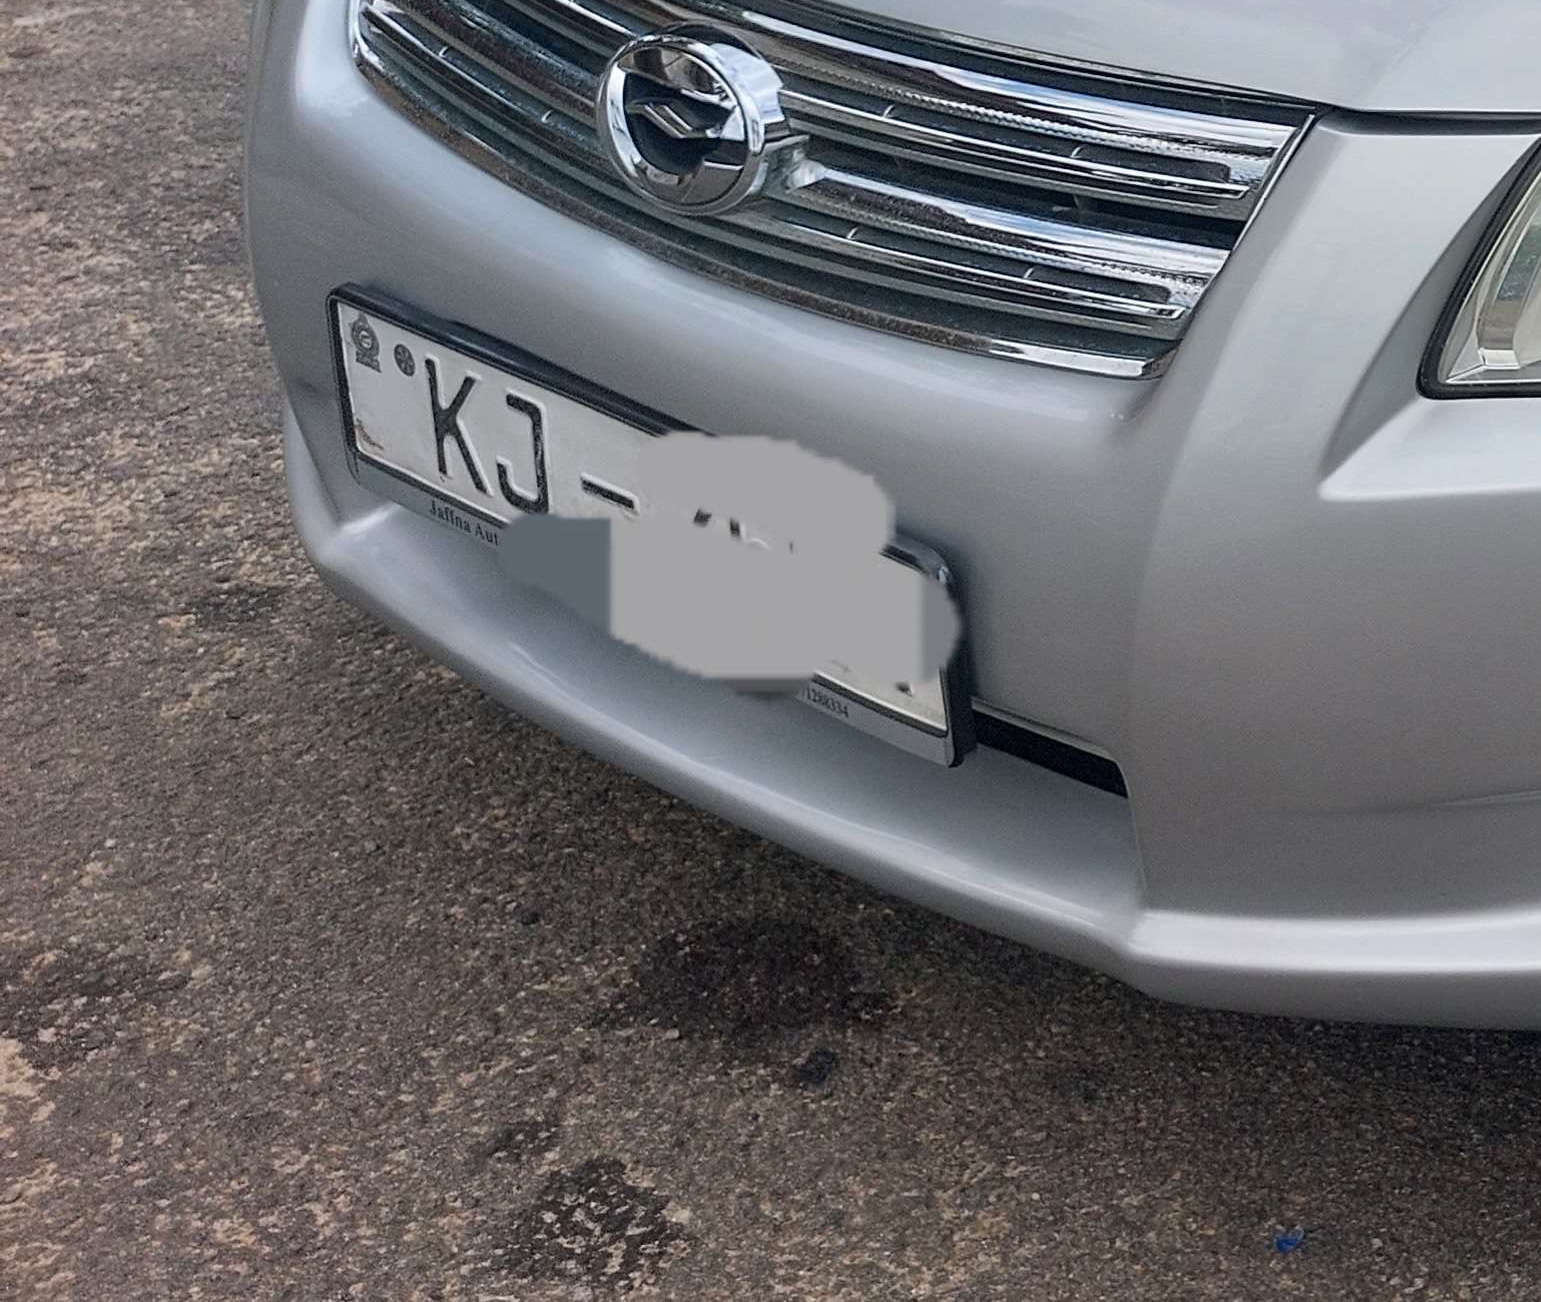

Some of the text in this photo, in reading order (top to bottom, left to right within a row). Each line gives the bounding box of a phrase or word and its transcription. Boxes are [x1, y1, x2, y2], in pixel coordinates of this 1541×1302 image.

[424, 355, 549, 515] KJ
[429, 499, 500, 546] Jaffna Aut
